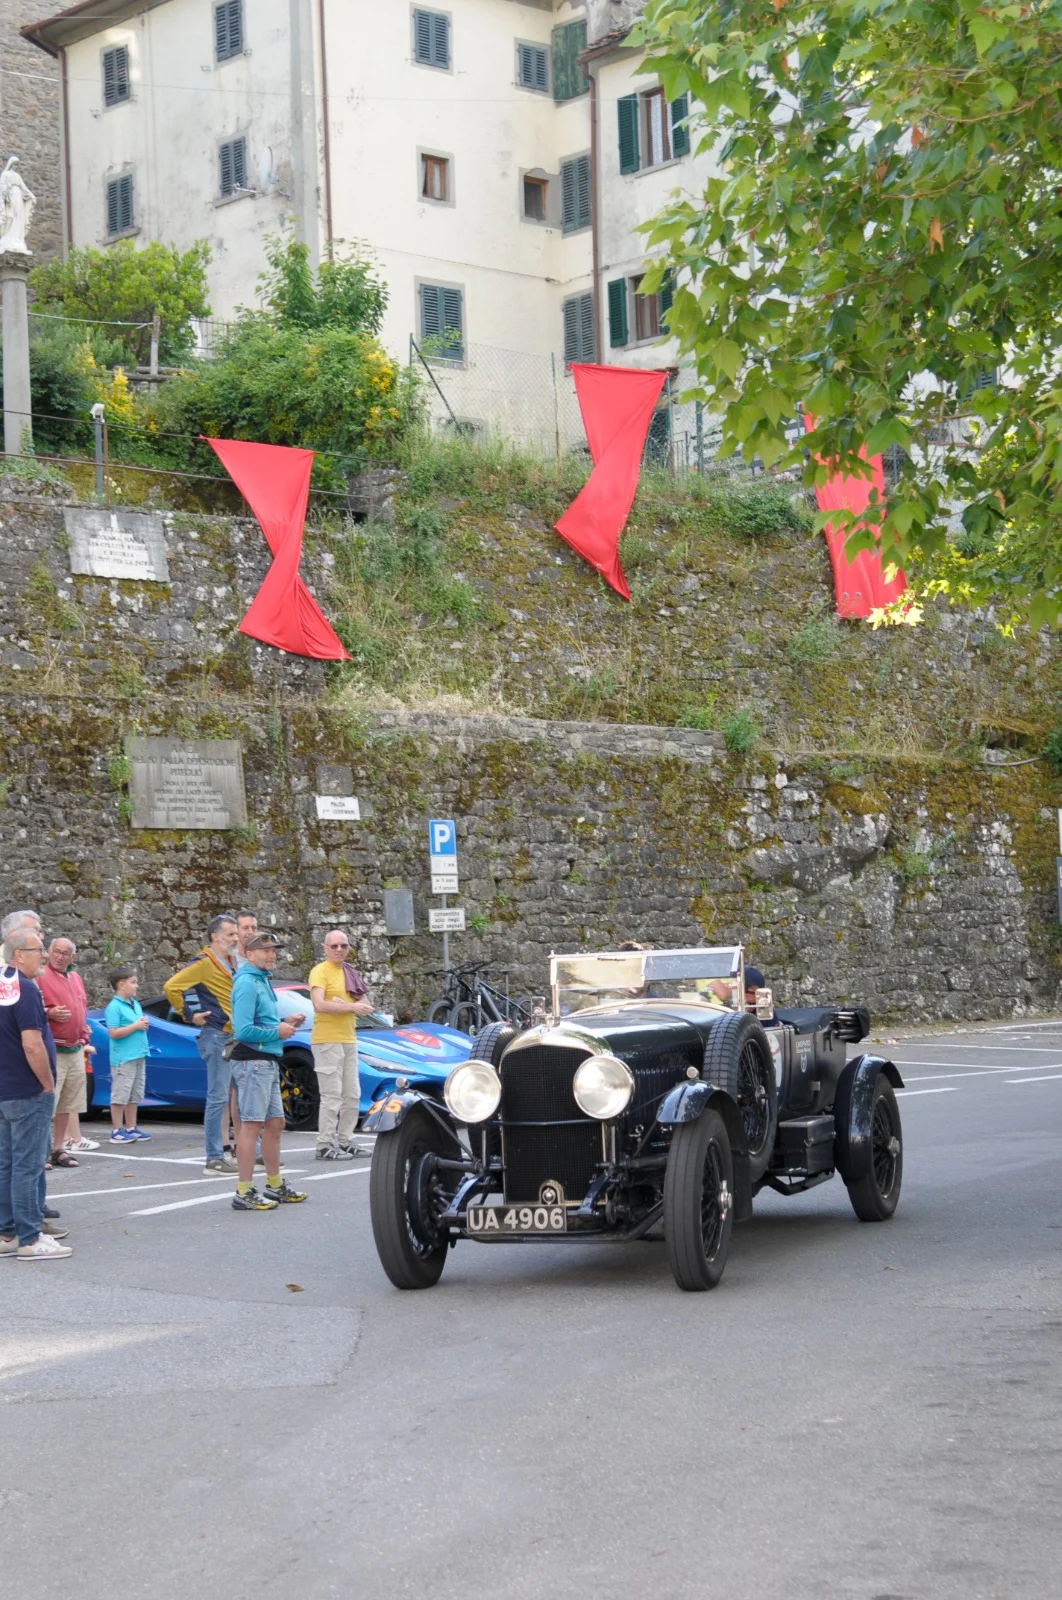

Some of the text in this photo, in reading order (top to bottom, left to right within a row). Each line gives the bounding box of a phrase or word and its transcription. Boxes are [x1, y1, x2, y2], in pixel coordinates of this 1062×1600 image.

[434, 823, 451, 853] P
[469, 1207, 564, 1230] UA 4906
